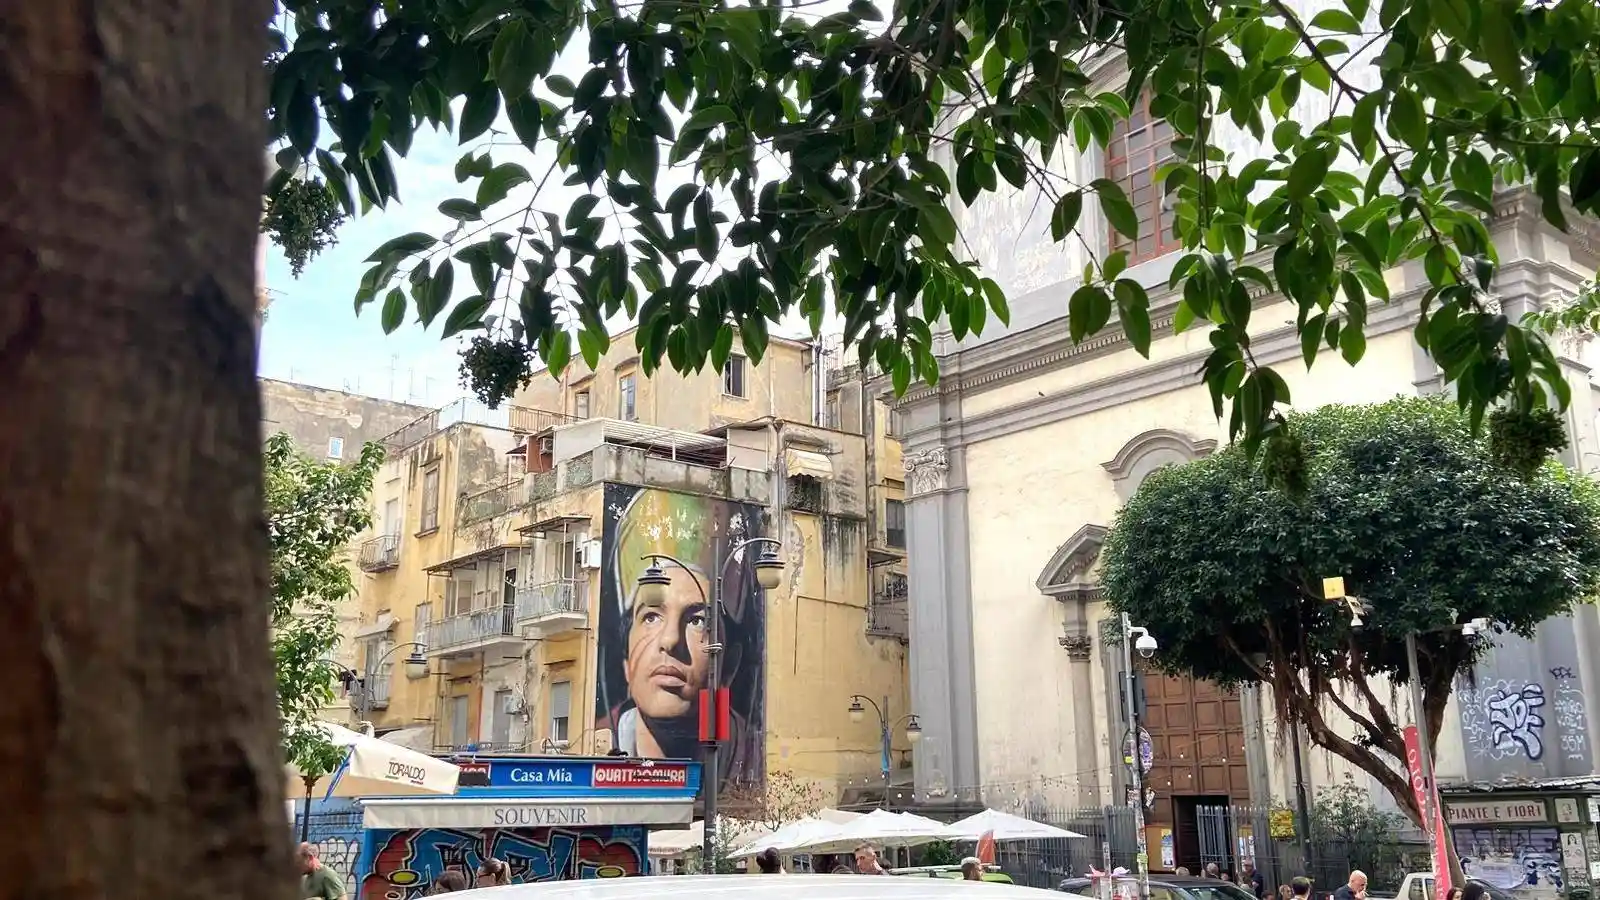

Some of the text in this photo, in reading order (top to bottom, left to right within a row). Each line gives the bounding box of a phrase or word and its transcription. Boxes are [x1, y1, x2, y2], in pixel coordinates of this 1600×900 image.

[388, 761, 426, 781] TORALDO
[510, 768, 573, 783] Casa Mia
[494, 806, 588, 825] SOUVENIR
[1449, 803, 1542, 819] PIANTE E FIORI
